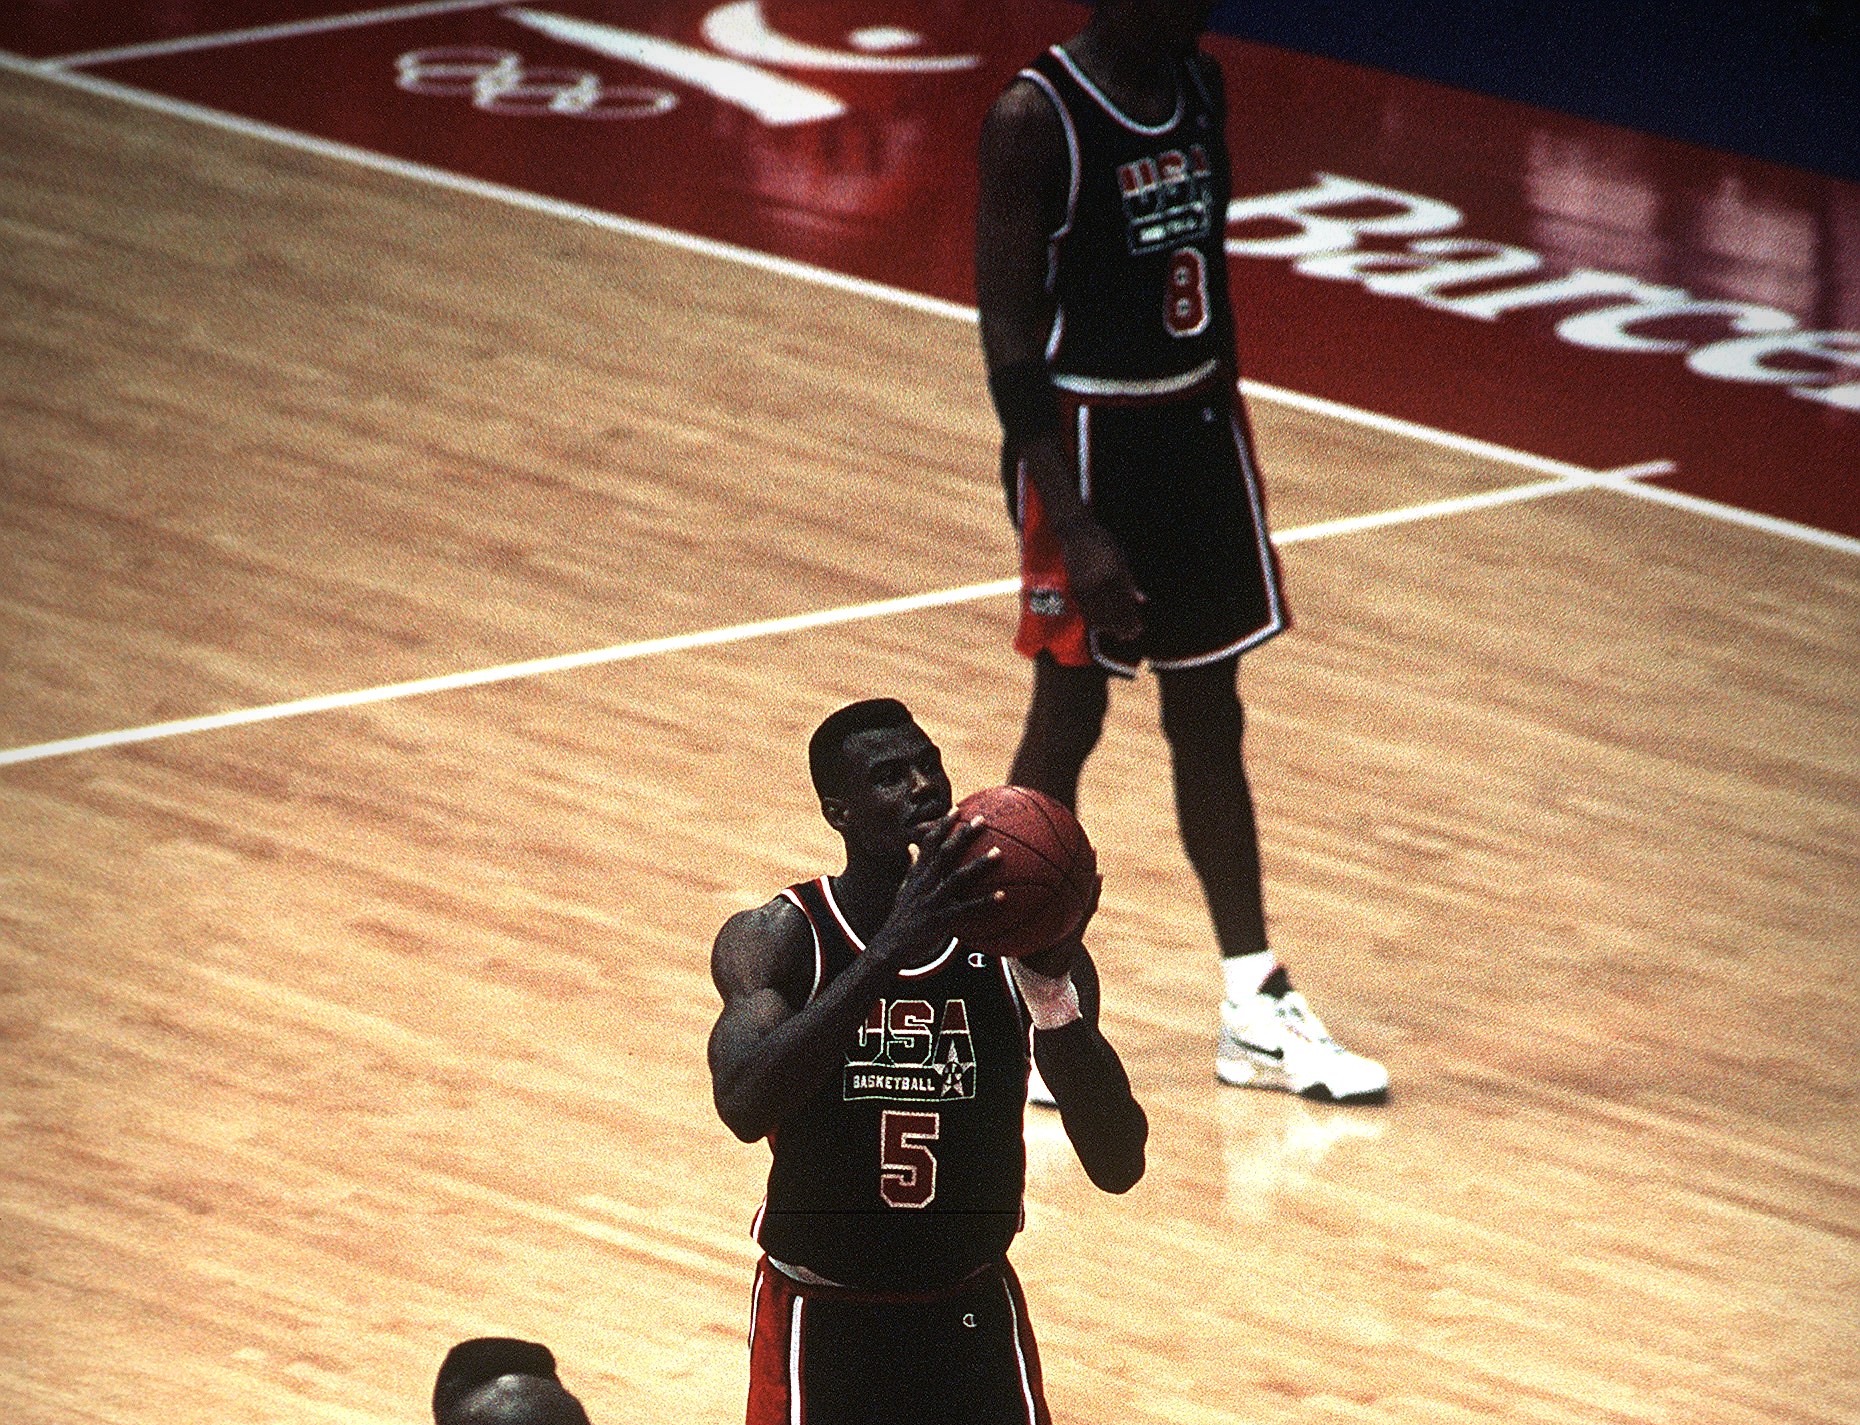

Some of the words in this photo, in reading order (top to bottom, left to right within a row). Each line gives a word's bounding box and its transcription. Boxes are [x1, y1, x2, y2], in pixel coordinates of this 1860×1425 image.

[1164, 247, 1211, 338] 8
[845, 998, 976, 1068] USA
[852, 1073, 936, 1093] BASKETBALL
[880, 1109, 940, 1209] 5
